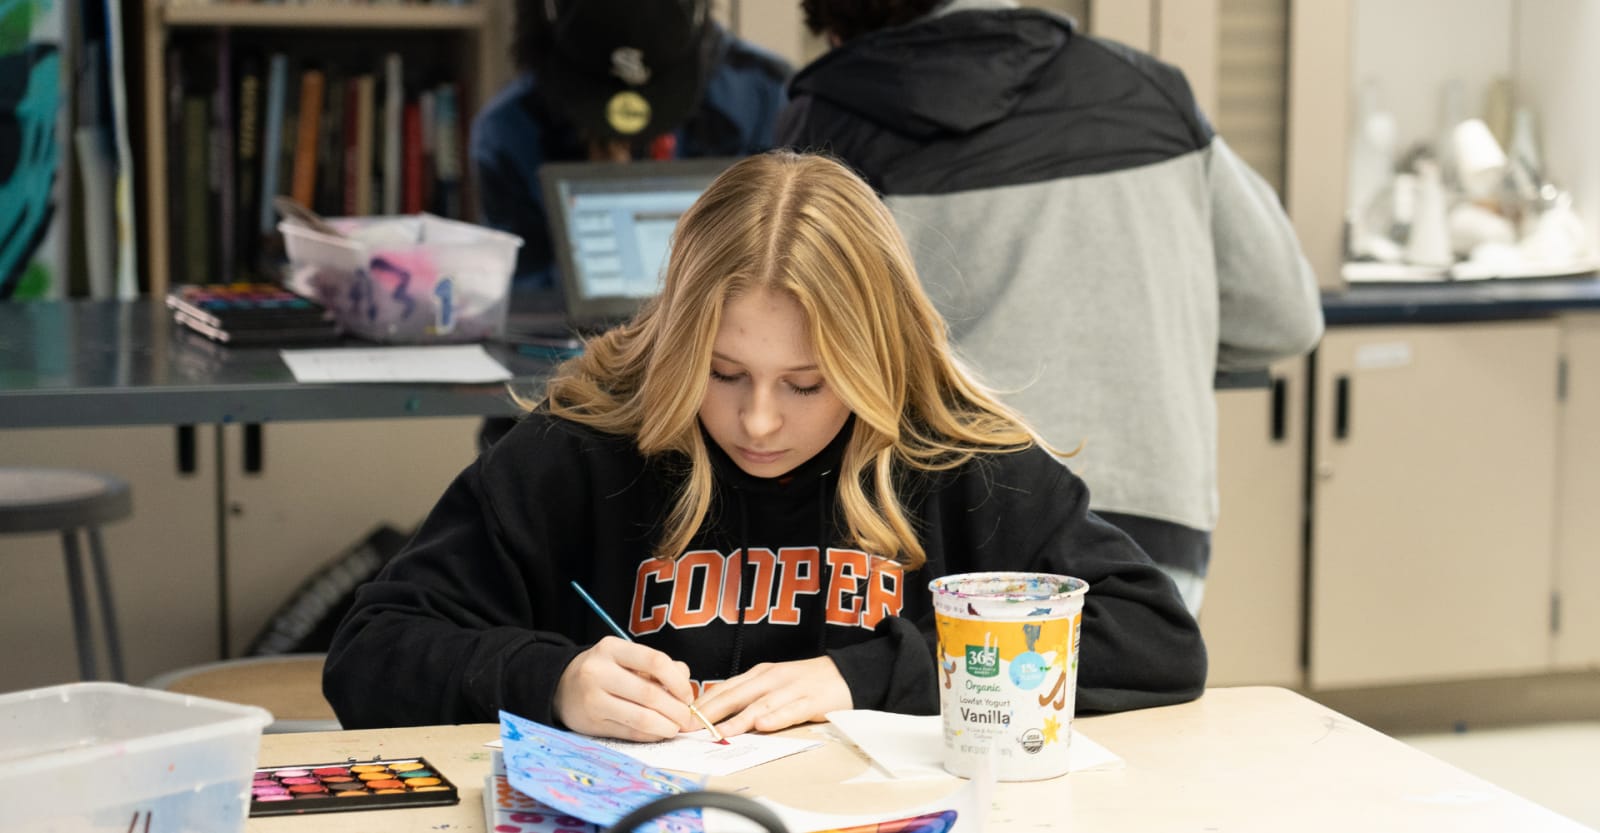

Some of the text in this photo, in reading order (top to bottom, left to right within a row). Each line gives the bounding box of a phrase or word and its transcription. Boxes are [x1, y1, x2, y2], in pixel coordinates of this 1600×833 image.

[628, 546, 905, 637] COOPER
[968, 650, 996, 667] 365
[965, 679, 1001, 695] Organic
[960, 696, 1010, 708] Lowfat Yogurt
[960, 707, 1011, 725] Vanilla
